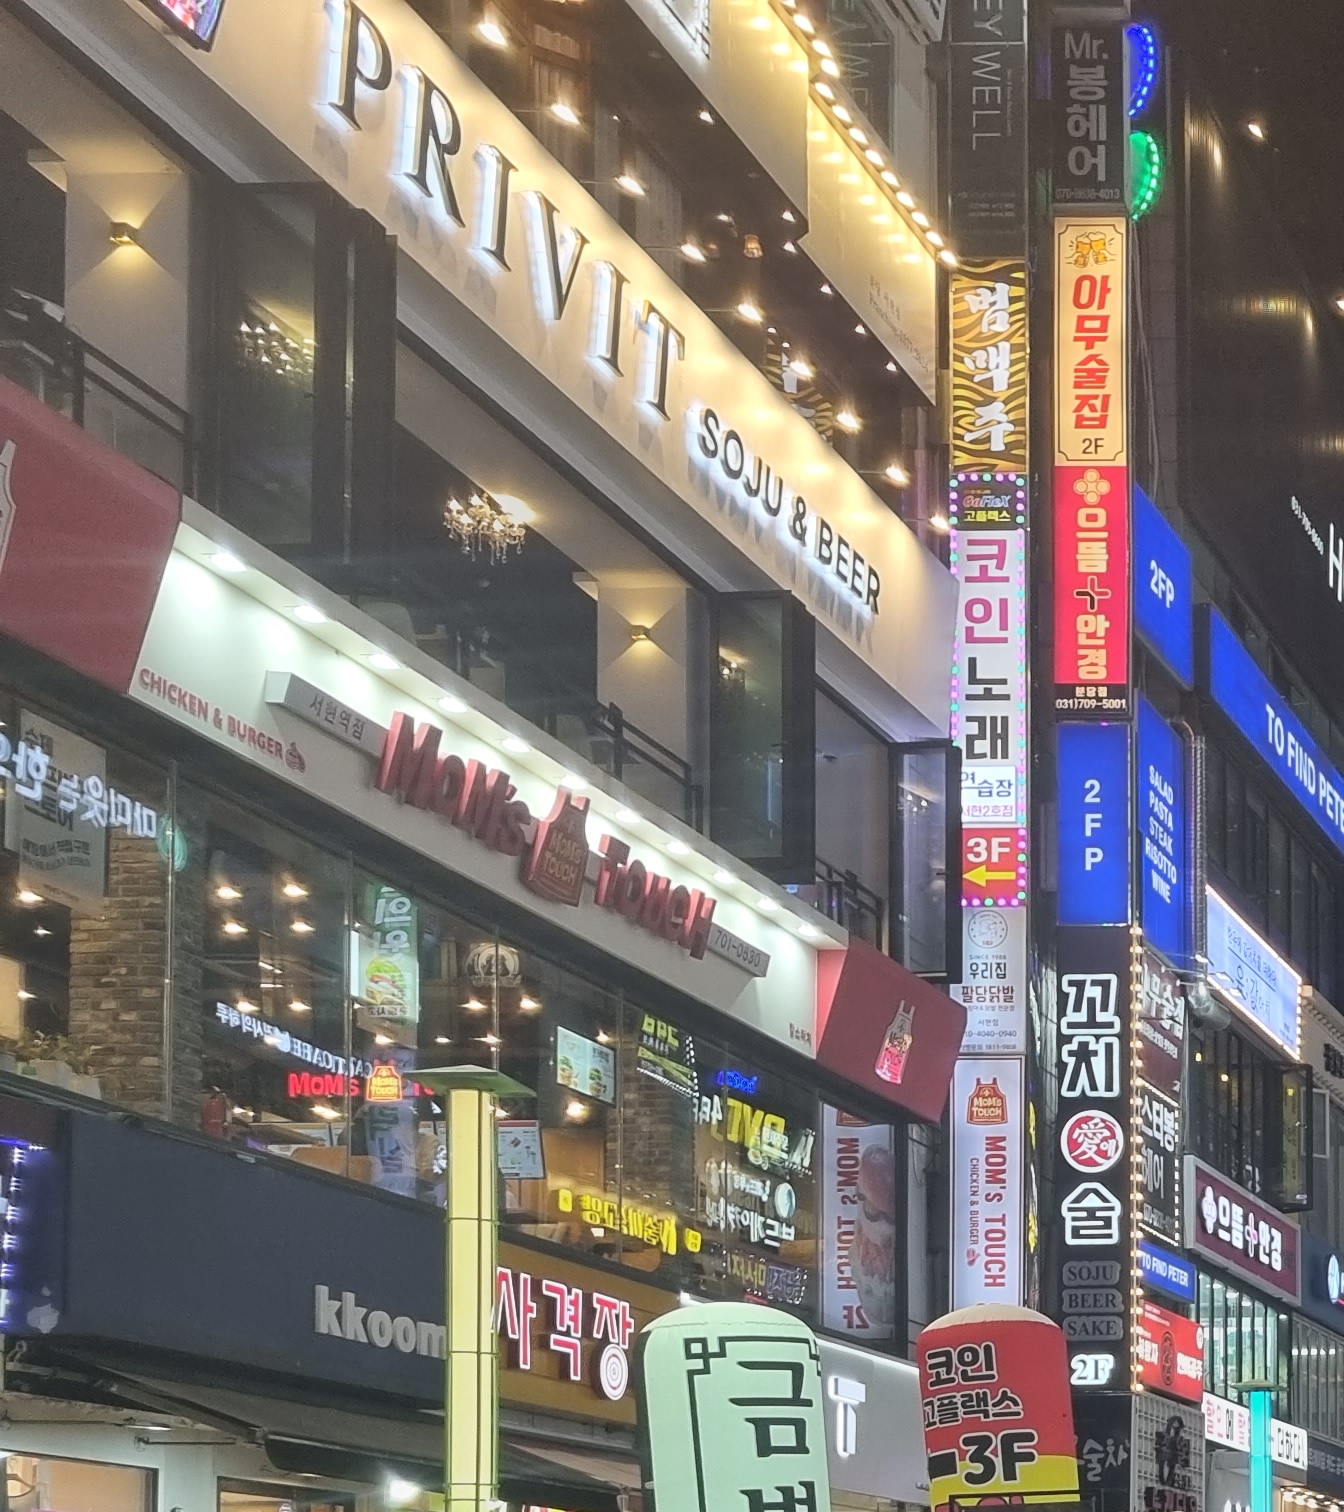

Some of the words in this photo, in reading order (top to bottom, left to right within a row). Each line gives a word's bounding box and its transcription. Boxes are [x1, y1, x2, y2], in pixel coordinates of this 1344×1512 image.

[1064, 31, 1109, 60] Mr.
[972, 51, 1001, 151] WELL
[1066, 63, 1109, 182] 봉헤어
[318, 0, 686, 420] PRIVIT
[1071, 273, 1112, 430] 아무술집
[1080, 436, 1105, 455] 2F
[697, 404, 783, 519] SOJU
[788, 492, 815, 552] &
[816, 517, 881, 615] BEER
[1076, 507, 1109, 573] 으뜸
[1150, 559, 1174, 607] 2FP
[1076, 614, 1110, 680] 안경
[139, 668, 209, 719] CHICKEN
[213, 709, 224, 728] &
[228, 715, 284, 760] BURGER
[309, 693, 366, 743] 서현역점
[1266, 704, 1284, 755] TO
[1287, 741, 1315, 795] FIND
[1150, 766, 1173, 805] SALAD
[1150, 790, 1173, 830] PASTA
[966, 837, 1011, 863] 3F
[1145, 838, 1177, 883] RISOTTO
[1149, 816, 1173, 855] STEAK
[1152, 869, 1170, 903] WINE
[969, 962, 1007, 979] 우리집
[982, 1136, 1006, 1208] MOM'S
[1062, 1182, 1120, 1245] 술
[1218, 1196, 1243, 1249] 으뜸
[1259, 1221, 1281, 1271] 안경
[982, 1216, 1005, 1289] TOUCH
[1067, 1262, 1115, 1284] SOJU
[1067, 1291, 1117, 1311] BEER
[496, 1267, 634, 1401] 사격장
[1067, 1320, 1117, 1336] SAKE
[927, 1343, 996, 1389] 코인
[960, 1430, 1038, 1486] 3F
